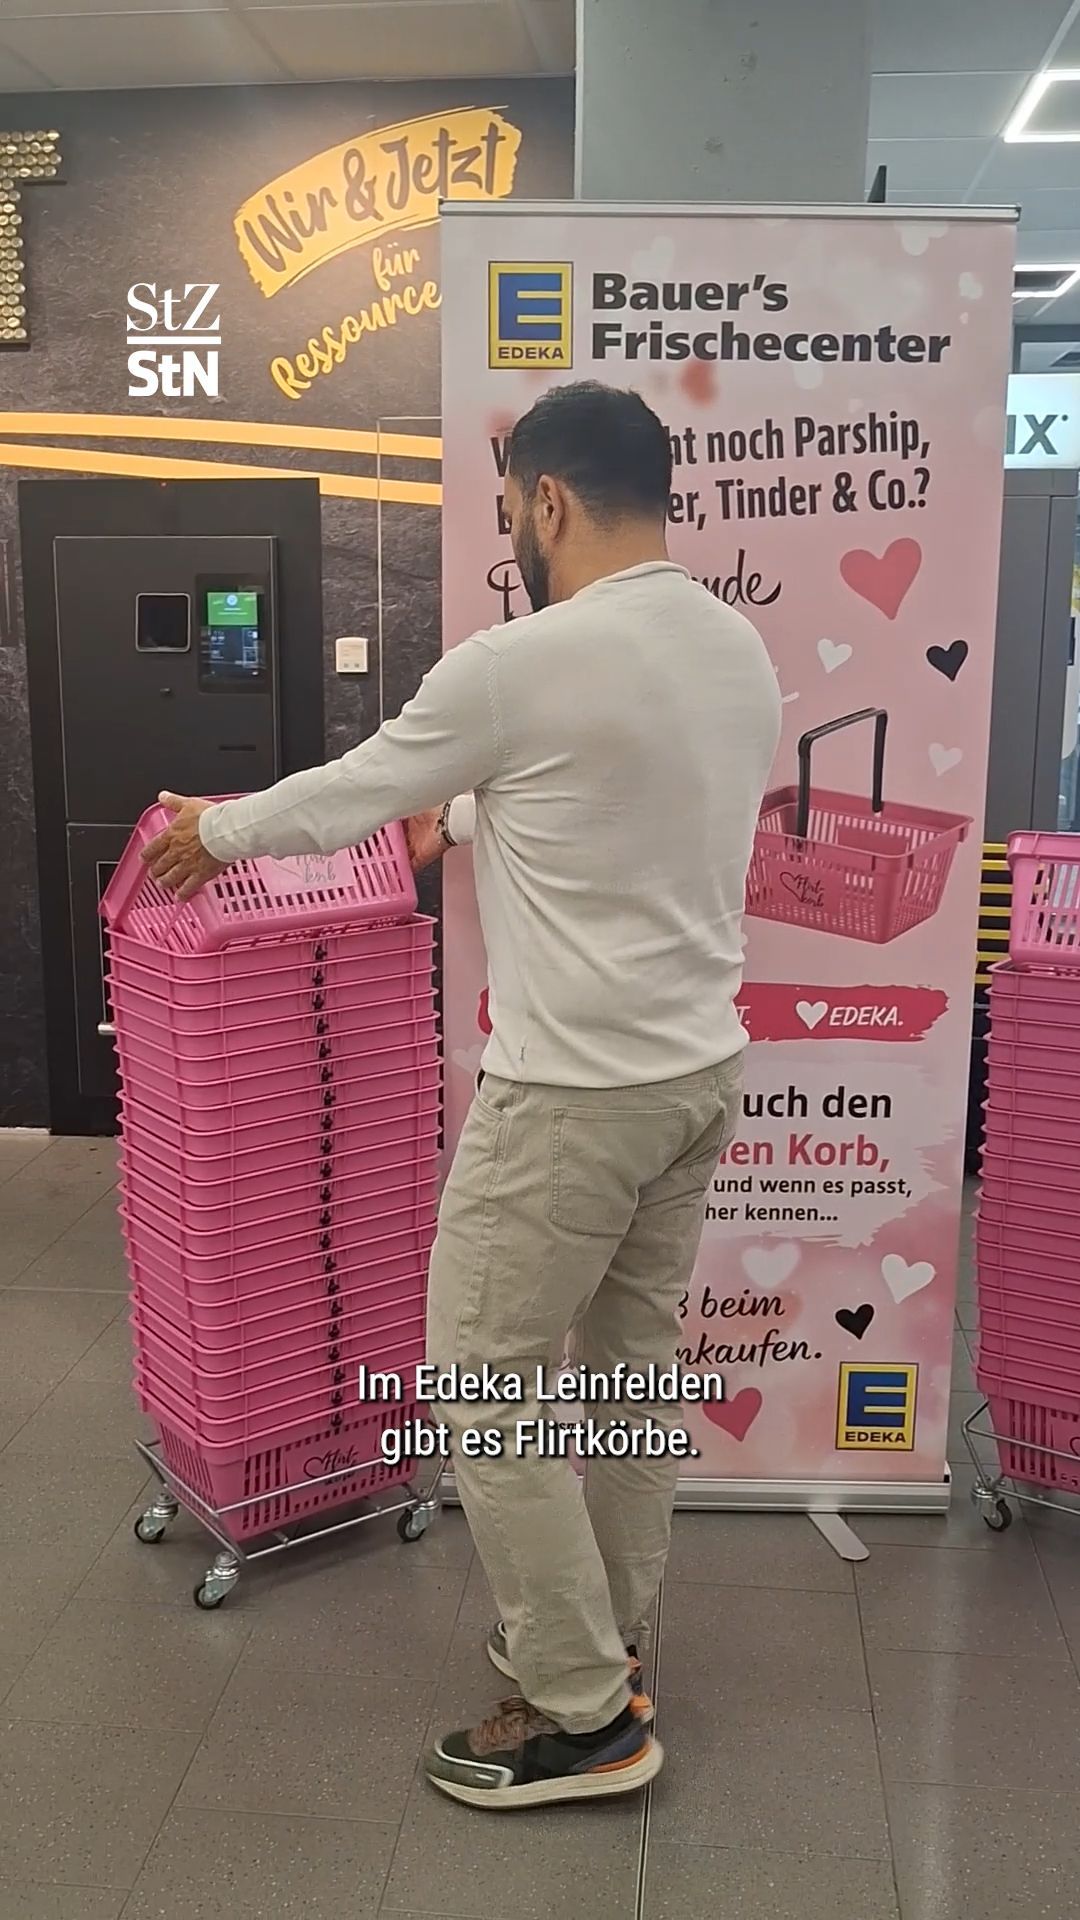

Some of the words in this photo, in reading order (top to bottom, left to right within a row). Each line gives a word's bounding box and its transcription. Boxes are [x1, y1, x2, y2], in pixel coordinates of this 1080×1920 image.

[243, 189, 338, 272] Wir
[344, 150, 384, 221] &
[380, 122, 506, 210] Jetzt
[373, 242, 421, 291] für
[498, 346, 564, 360] EDEKA
[592, 321, 951, 363] Frischecenter
[707, 418, 784, 463] noch
[799, 411, 931, 460] Parship,
[668, 490, 707, 530] er,
[716, 475, 823, 521] Tinder
[832, 478, 858, 513] &
[868, 467, 931, 509] Co.?
[829, 1006, 904, 1026] EDEKA.
[743, 1086, 807, 1118] uch
[822, 1086, 892, 1118] den
[789, 1134, 890, 1172] Korb,
[714, 1177, 752, 1193] und
[760, 1180, 815, 1193] wenn
[823, 1180, 843, 1193] es
[851, 1178, 912, 1197] passt,
[705, 1204, 738, 1220] her
[745, 1204, 838, 1221] kennen...
[701, 1286, 784, 1318] beim
[675, 1329, 822, 1367] nkaufen.
[844, 1431, 907, 1443] EDEKA
